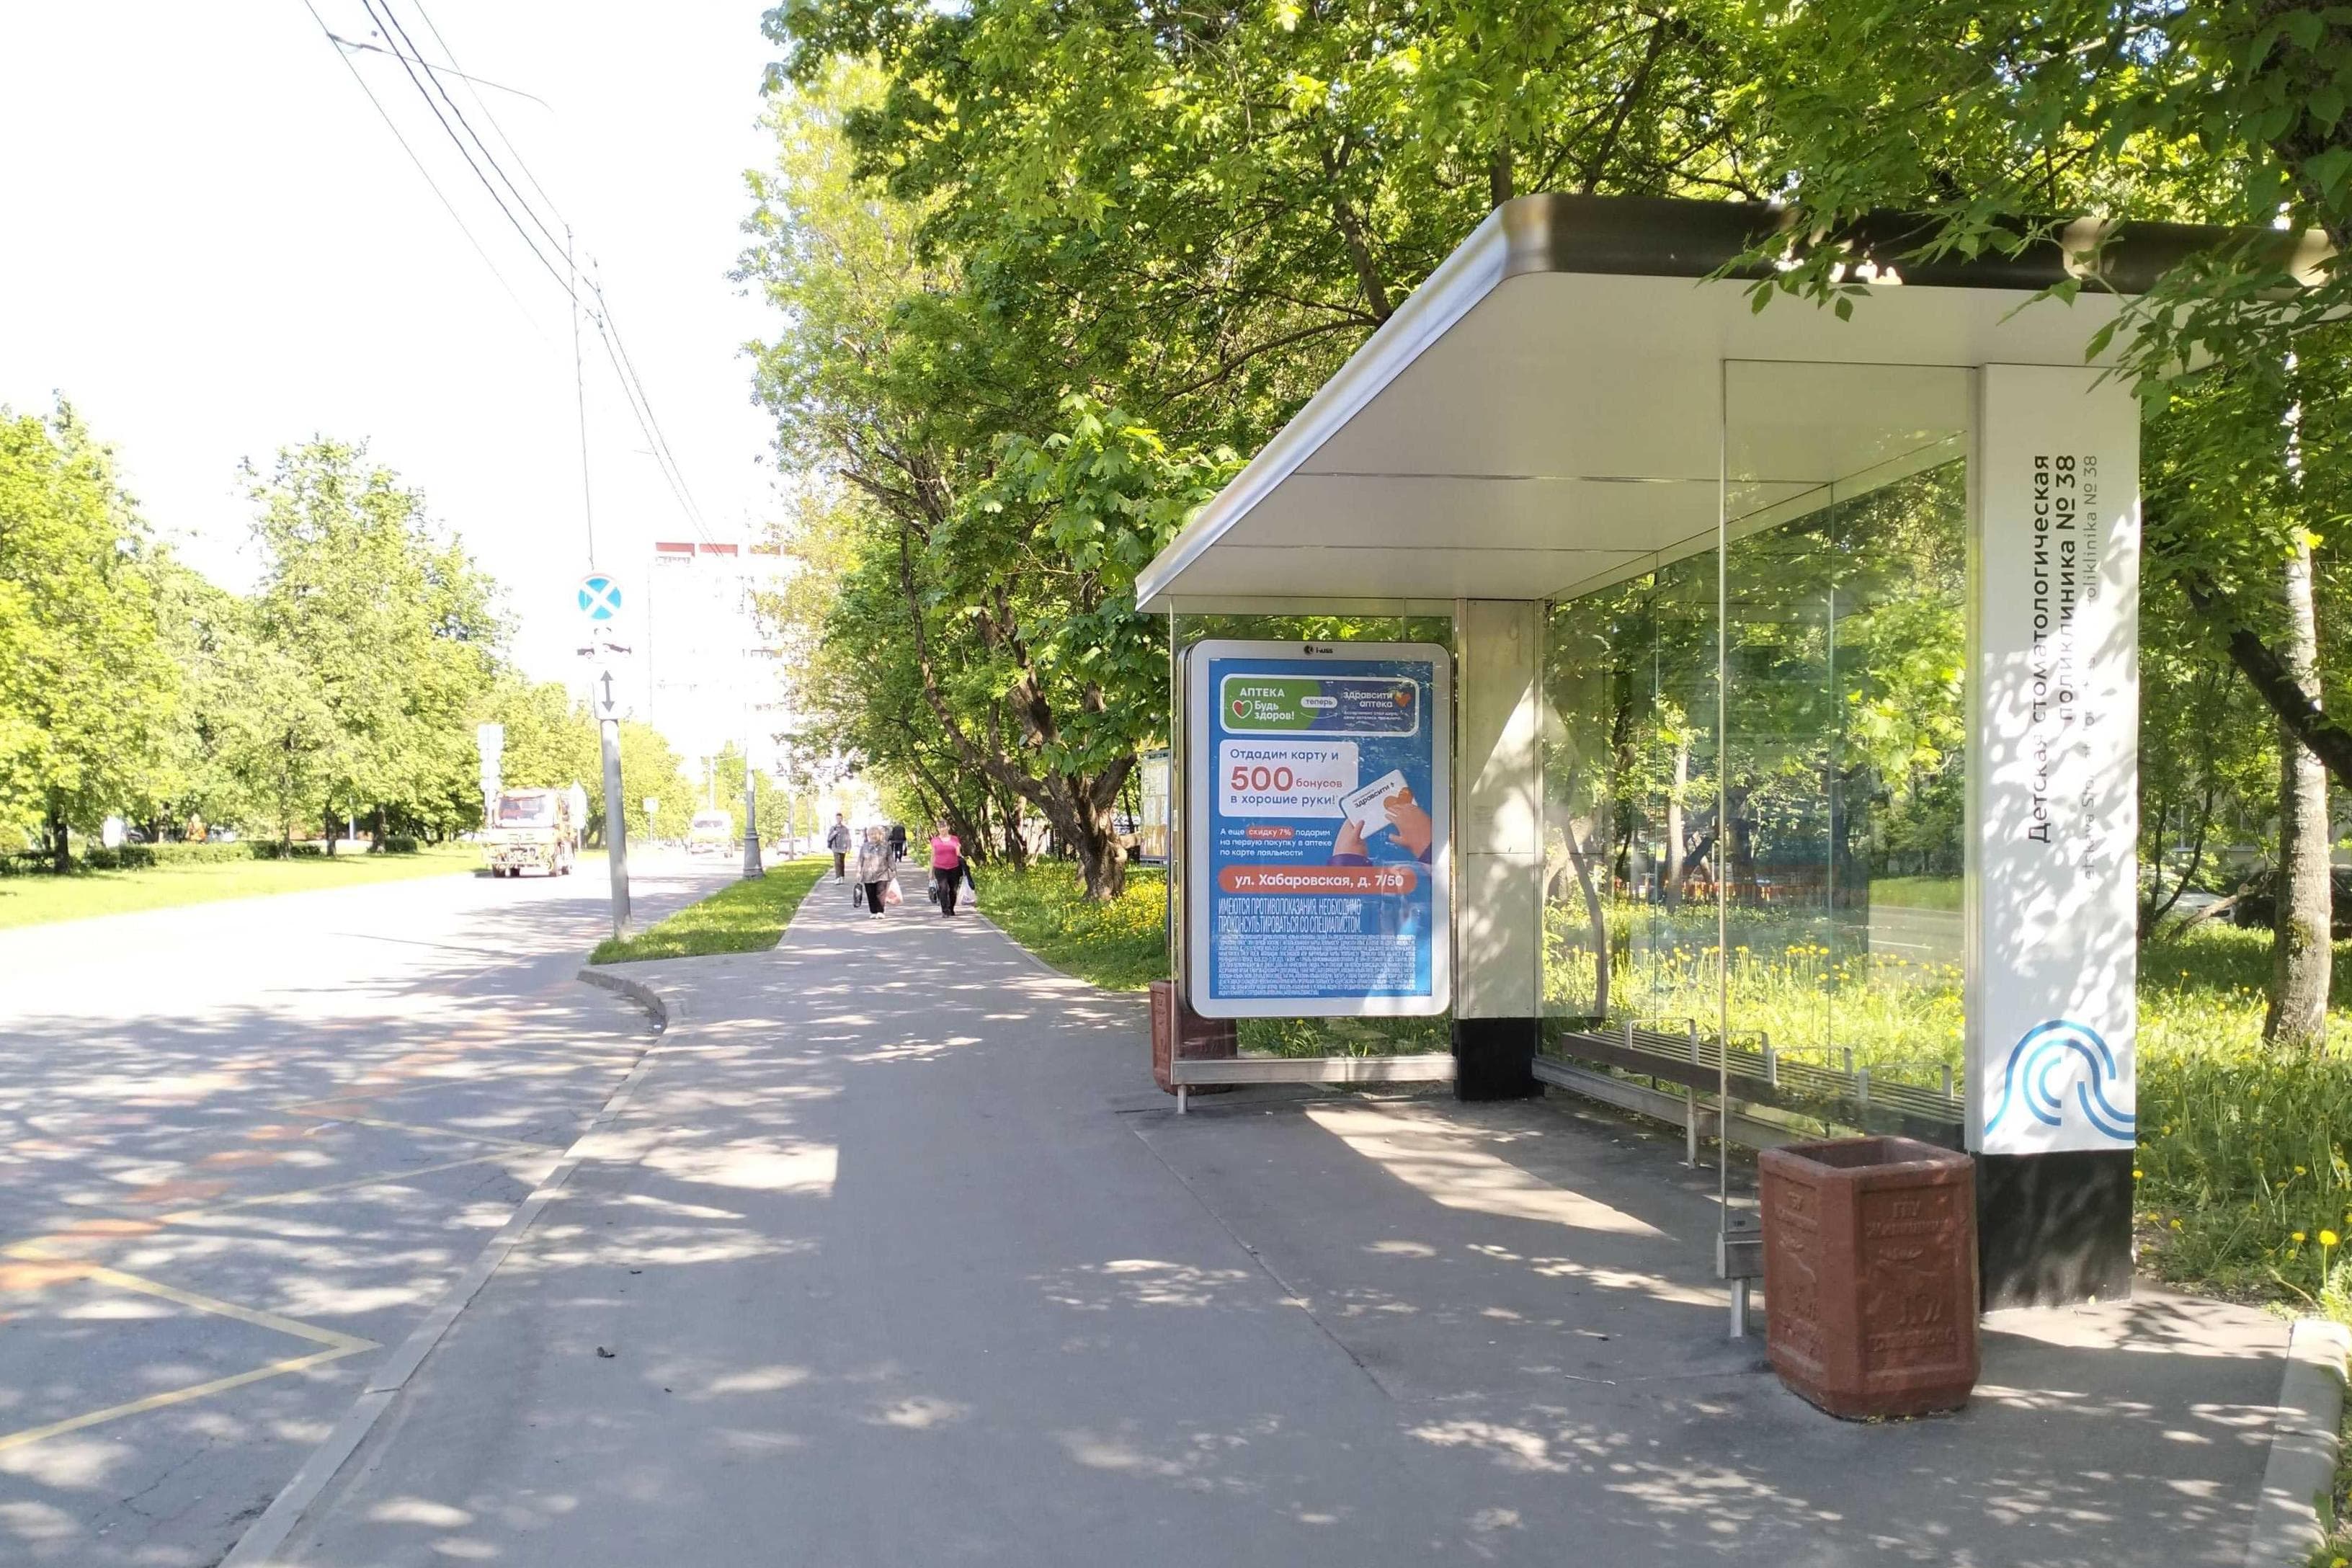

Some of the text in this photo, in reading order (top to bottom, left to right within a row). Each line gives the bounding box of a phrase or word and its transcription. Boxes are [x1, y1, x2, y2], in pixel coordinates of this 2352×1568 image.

[2083, 455, 2097, 477] 38
[2082, 512, 2097, 614] oliklinika
[2056, 455, 2075, 721] поликлиника № 38
[2028, 455, 2052, 844] Детская стоматологическая
[1239, 687, 1285, 698] АПТЕКА
[1343, 691, 1393, 700] здравсити
[1255, 700, 1279, 712] Будь
[1359, 700, 1393, 708] аптека
[1254, 711, 1295, 721] здоров!
[1230, 749, 1287, 760] Отдадим
[1291, 752, 1327, 762] карту
[1231, 766, 1342, 791] 500 бонусов
[1242, 796, 1298, 805] хорошие
[1301, 795, 1335, 807] руки!
[1249, 829, 1278, 837] скидку
[1232, 839, 1262, 848] первую
[1264, 839, 1297, 848] покупку
[1235, 875, 1255, 888] ул.
[1259, 873, 1355, 888] Хабаровская,
[1357, 876, 1371, 887] д.
[1219, 898, 1250, 914] ИМЕЮТСЯ
[1319, 898, 1362, 916] НЕОБХОДИМО
[1219, 916, 1298, 933] ПРОКОНСУЛЬТИРОВАТЬСЯ
[1300, 916, 1309, 933] СО
